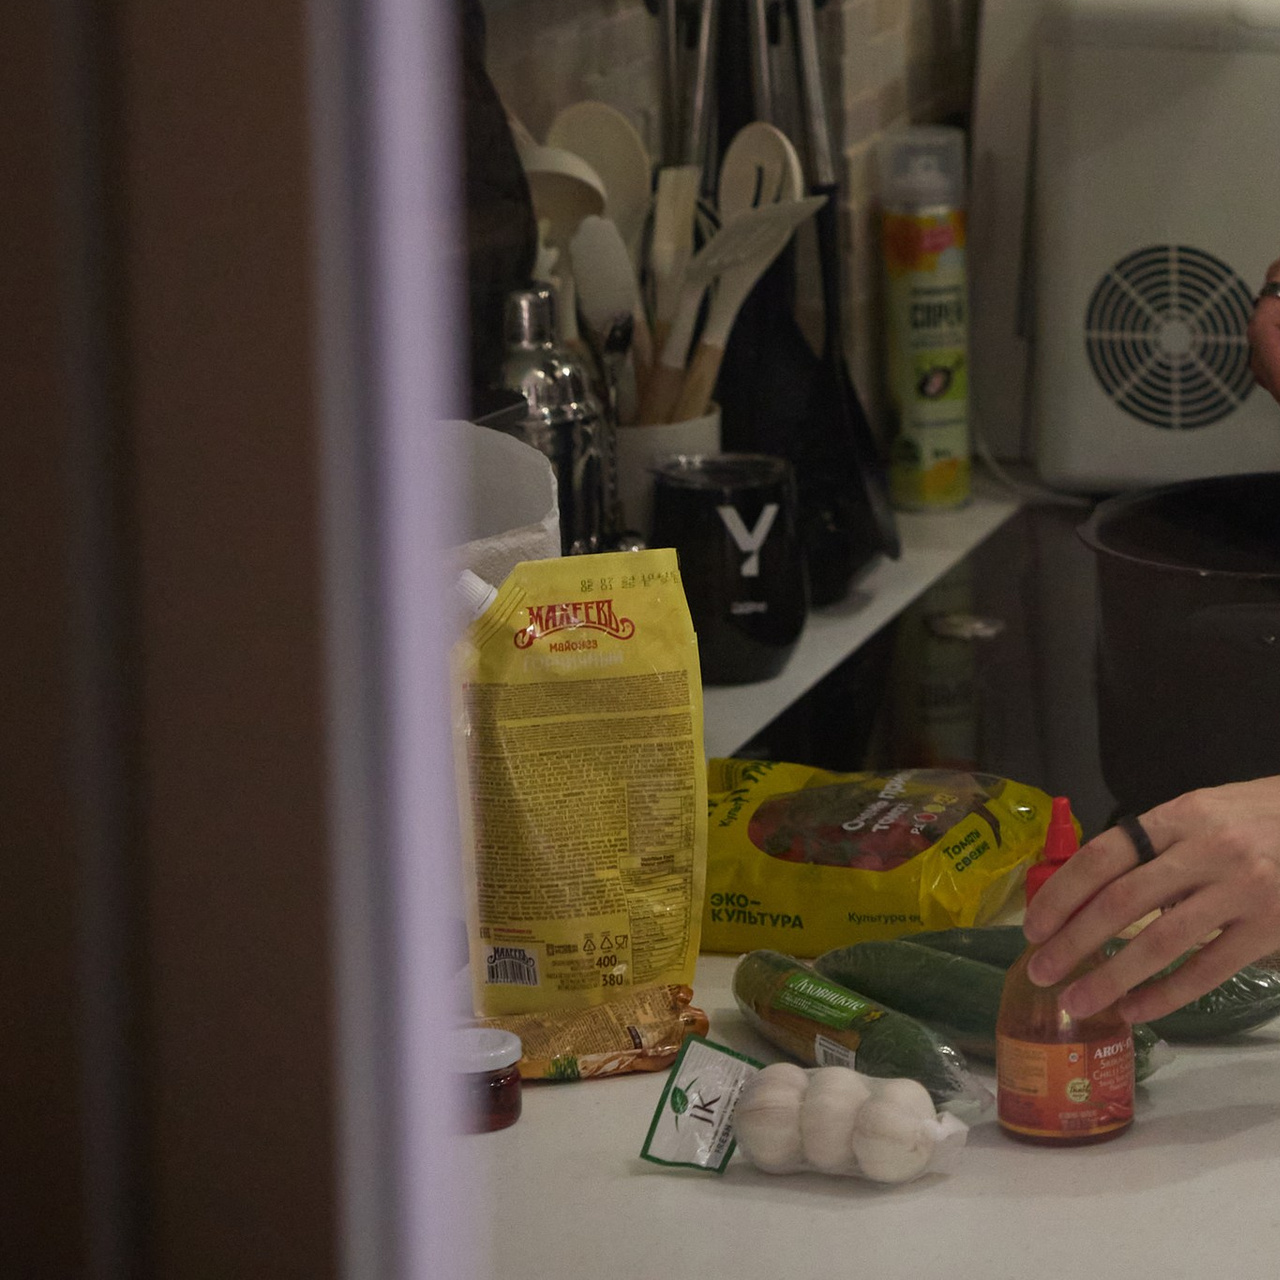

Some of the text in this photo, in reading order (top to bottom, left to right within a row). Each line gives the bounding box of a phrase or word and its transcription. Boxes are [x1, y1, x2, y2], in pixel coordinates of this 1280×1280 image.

[717, 503, 779, 577] Y
[710, 892, 762, 908] ЭКО-
[711, 908, 804, 929] КУЛЬТУРА
[596, 954, 617, 968] 400
[602, 974, 623, 986] 380
[690, 1091, 721, 1127] JK
